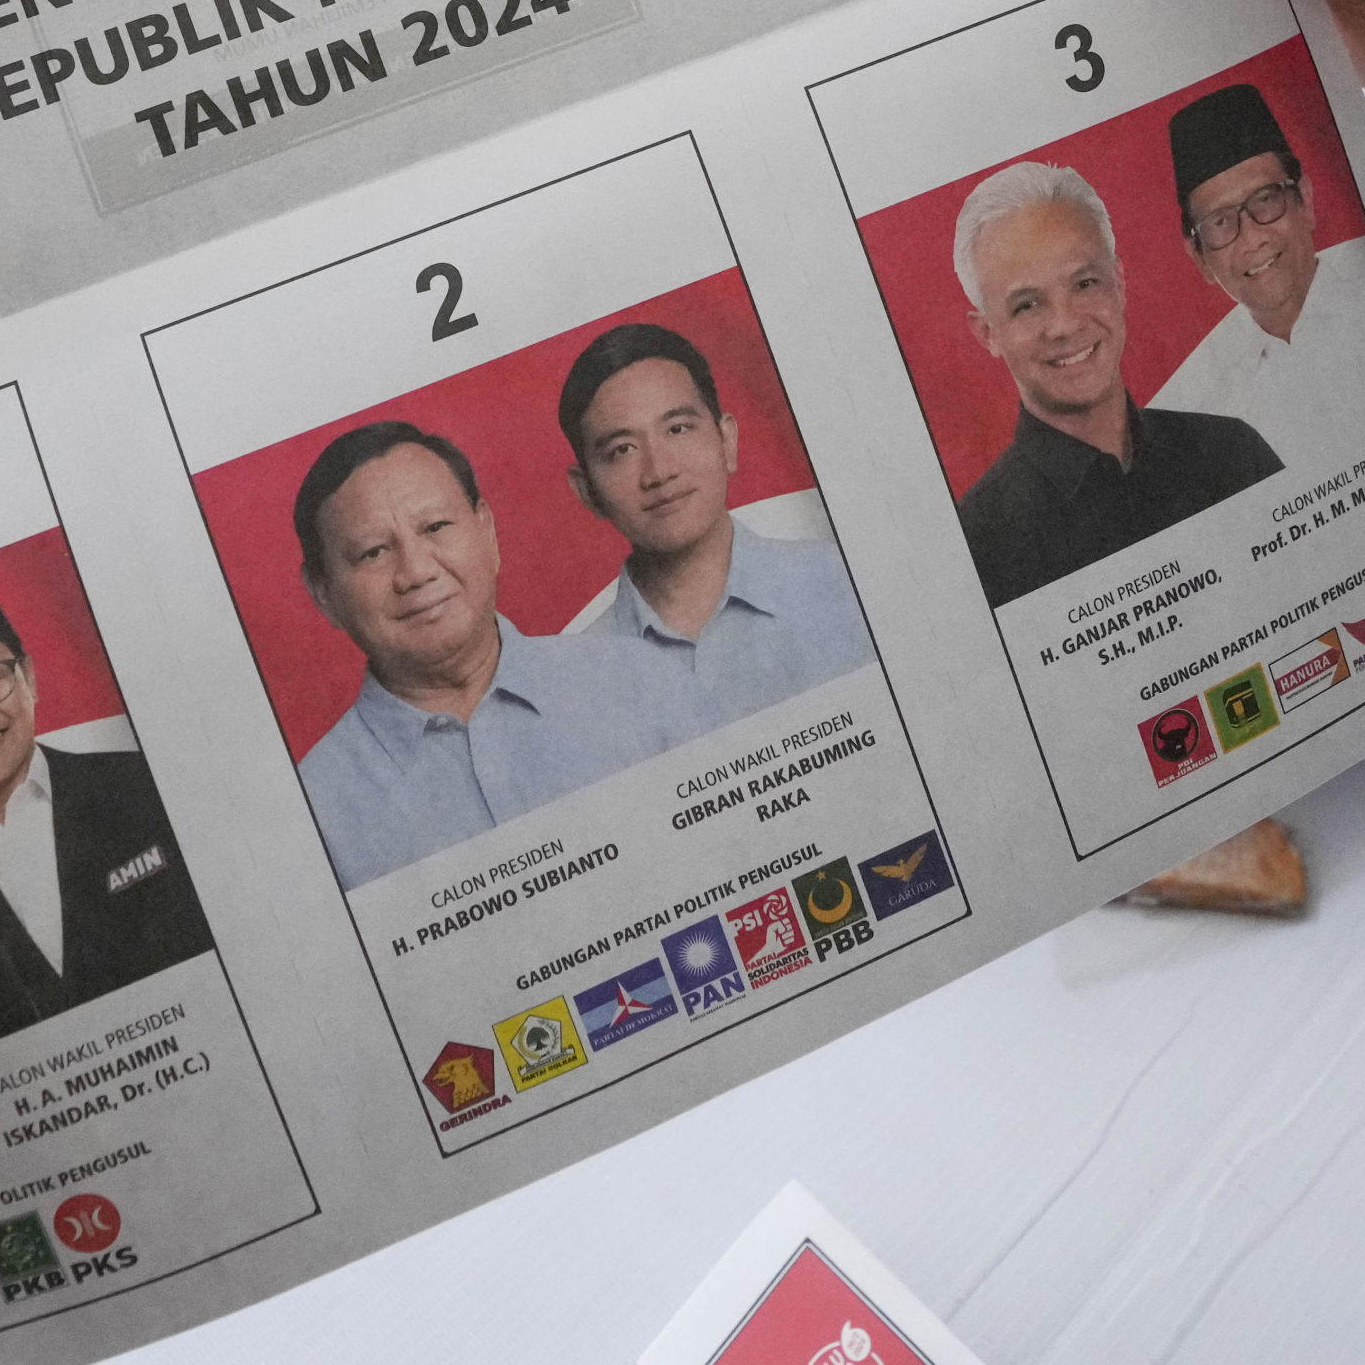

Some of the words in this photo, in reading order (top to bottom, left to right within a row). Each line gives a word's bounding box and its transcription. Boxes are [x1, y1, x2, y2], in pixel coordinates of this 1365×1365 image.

[1054, 23, 1106, 93] 3
[135, 28, 389, 159] TAHUN
[415, 262, 479, 343] 2
[1272, 491, 1314, 523] CALON
[1313, 470, 1353, 500] WAKIL
[1251, 532, 1288, 562] Prof.
[1289, 523, 1312, 543] Dr.
[1312, 511, 1330, 529] H.
[1330, 499, 1351, 520] M.
[1040, 647, 1060, 666] H.
[1062, 612, 1131, 655] GANJAR
[1132, 569, 1222, 622] PRANOWO,
[1068, 591, 1115, 624] CALON
[1117, 560, 1182, 601] PRESIDEN
[1098, 640, 1135, 666] S.H.,
[1137, 614, 1183, 647] M.I.P.
[1139, 651, 1220, 701] GABUNGAN
[1221, 625, 1269, 660] PARTAI
[1270, 598, 1320, 635] POLITIK
[1280, 655, 1332, 692] HANURA
[671, 786, 745, 830] GIBRAN
[747, 729, 876, 798] RAKABUMING
[676, 765, 729, 799] CALON
[729, 744, 781, 776] WAKIL
[781, 711, 854, 754] PRESIDEN
[755, 787, 811, 823] RAKA
[108, 844, 165, 892] AMIN
[431, 873, 487, 908] CALON
[488, 838, 565, 883] PRESIDEN
[888, 879, 937, 907] GARUDA
[391, 937, 415, 957] H.
[416, 889, 518, 946] PRABOWO
[521, 843, 619, 899] SUBIANTO
[516, 938, 612, 991] GABUNGAN
[613, 909, 671, 947] PARTAI
[673, 879, 737, 920] POLITIK
[737, 842, 823, 890] PENGUSUL
[733, 912, 763, 937] PSI
[745, 952, 777, 972] PARTAI
[748, 947, 810, 981] SOLIDARITAS
[813, 920, 875, 964] PBB
[682, 970, 746, 1017] PAN
[750, 956, 813, 990] INDONESIA
[46, 1040, 104, 1073] WAKIL
[104, 1003, 186, 1050] PRESIDEN
[592, 1026, 625, 1047] PARTAI
[625, 1004, 673, 1033] DEMOKRAT
[2, 1094, 118, 1148] ISKANDAR,
[120, 1081, 153, 1103] Dr.
[154, 1051, 211, 1091] (H.C.)
[13, 1098, 37, 1116] H.
[41, 1088, 63, 1109] A.
[64, 1035, 179, 1097] MUHAIMIN
[439, 1094, 512, 1132] GERINDRA
[57, 1141, 152, 1187] PENGUSUL
[3, 1269, 66, 1303] PKB
[70, 1246, 139, 1285] PKS
